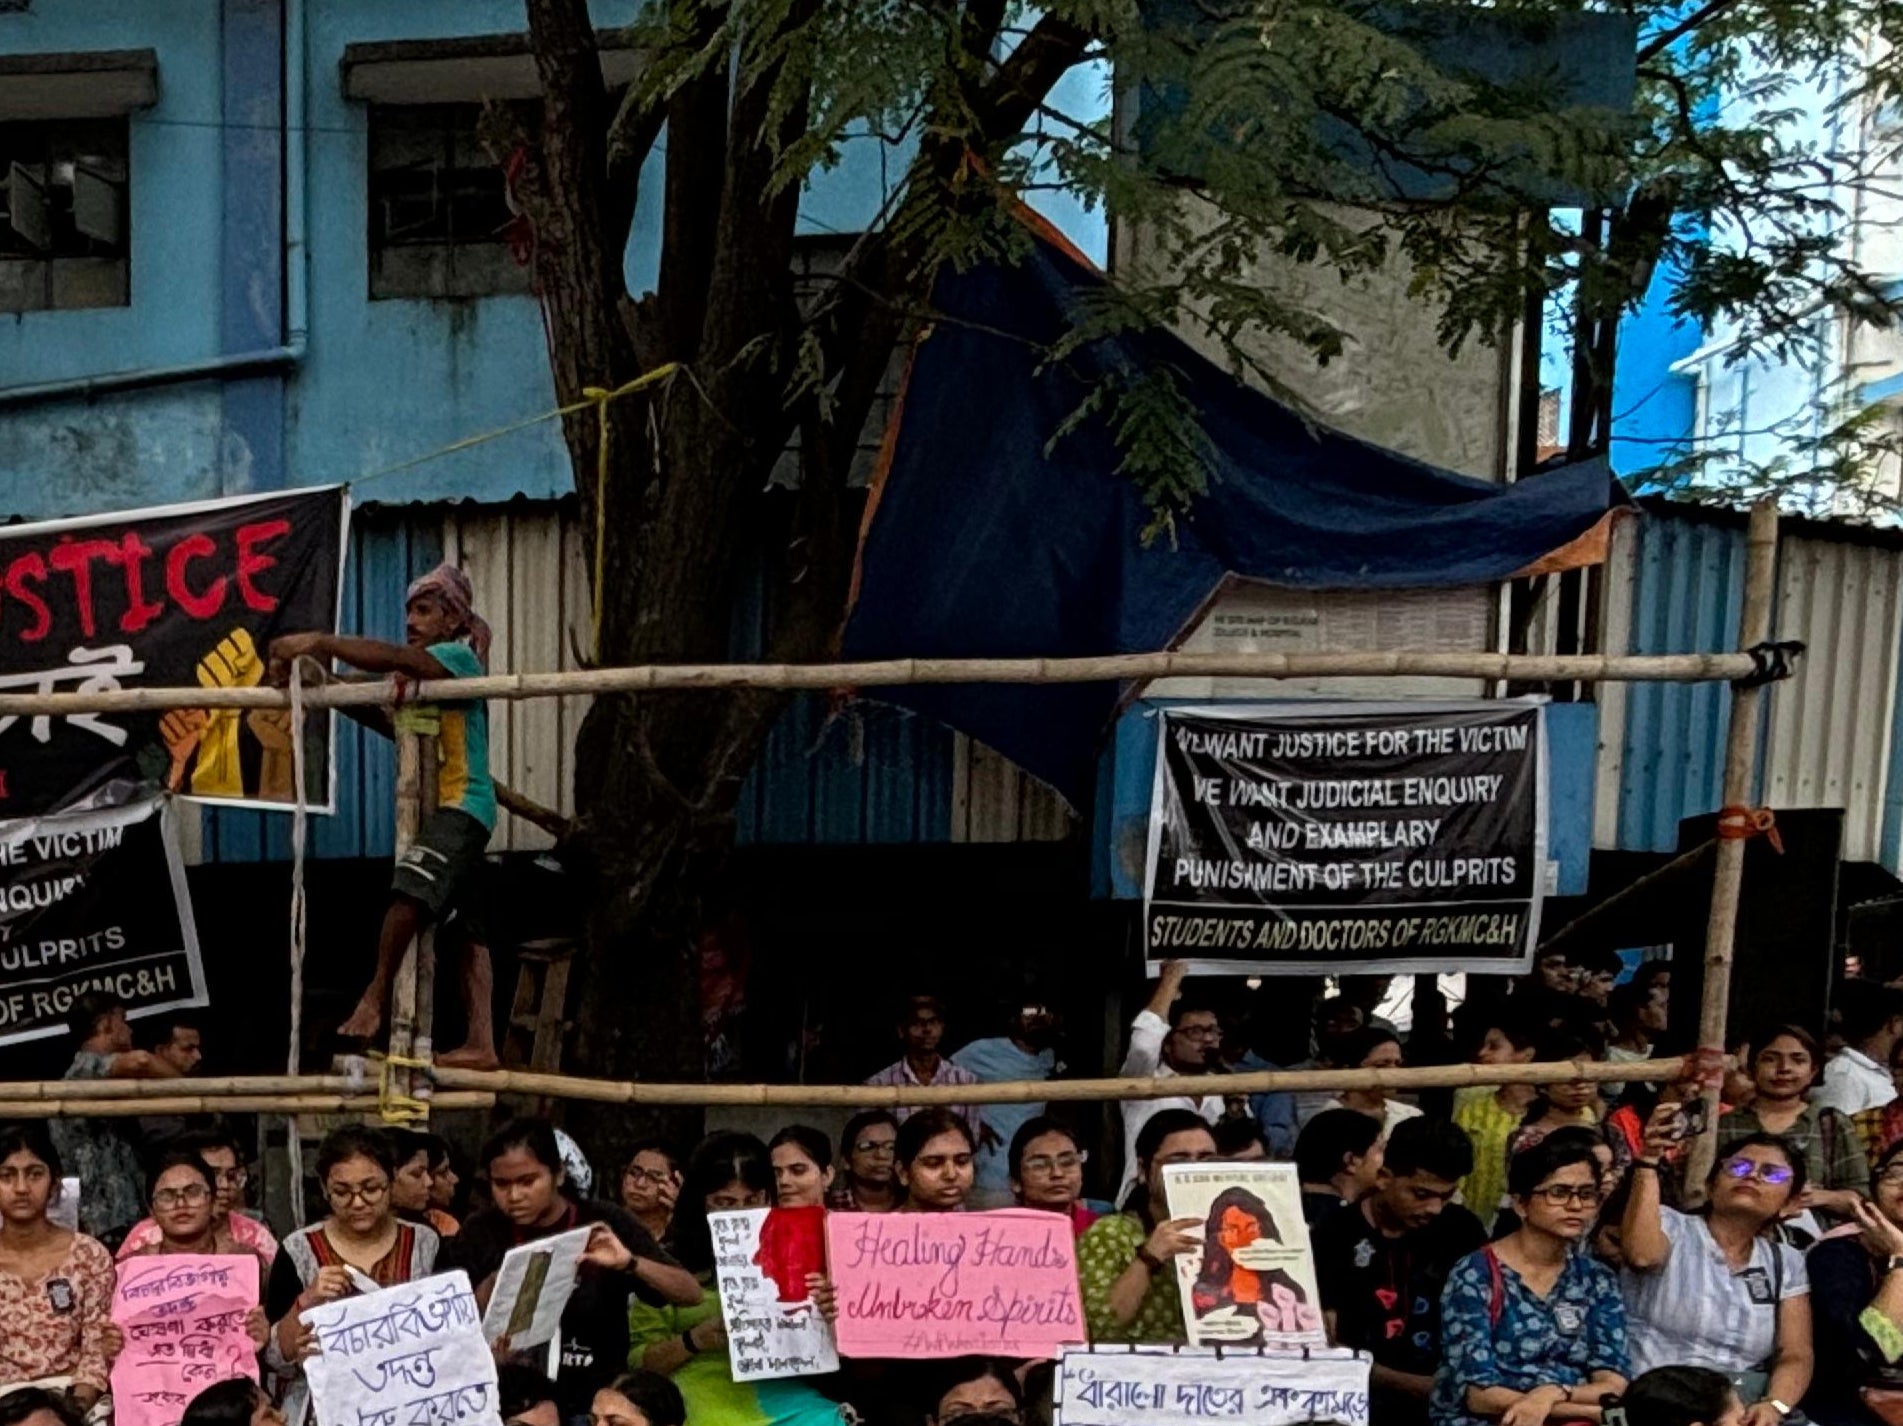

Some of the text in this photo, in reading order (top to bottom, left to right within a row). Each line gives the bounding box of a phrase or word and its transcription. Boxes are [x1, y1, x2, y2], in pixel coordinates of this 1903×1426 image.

[1205, 722, 1529, 762] WANT JUSTICE FOR THE VICTIM
[1228, 773, 1504, 811] WANT JUDICIAL ENQUIRY
[1246, 817, 1443, 851] AND EXAMPLARY
[1173, 856, 1518, 893] PUNISHMENT OF THE CULPRITS
[1150, 912, 1520, 952] STUDENTS AND DOCTORS OF RGKMC&H
[846, 1219, 1069, 1299] Healing Hands
[847, 1285, 976, 1322] Unbroken
[977, 1280, 1078, 1338] Spirits
